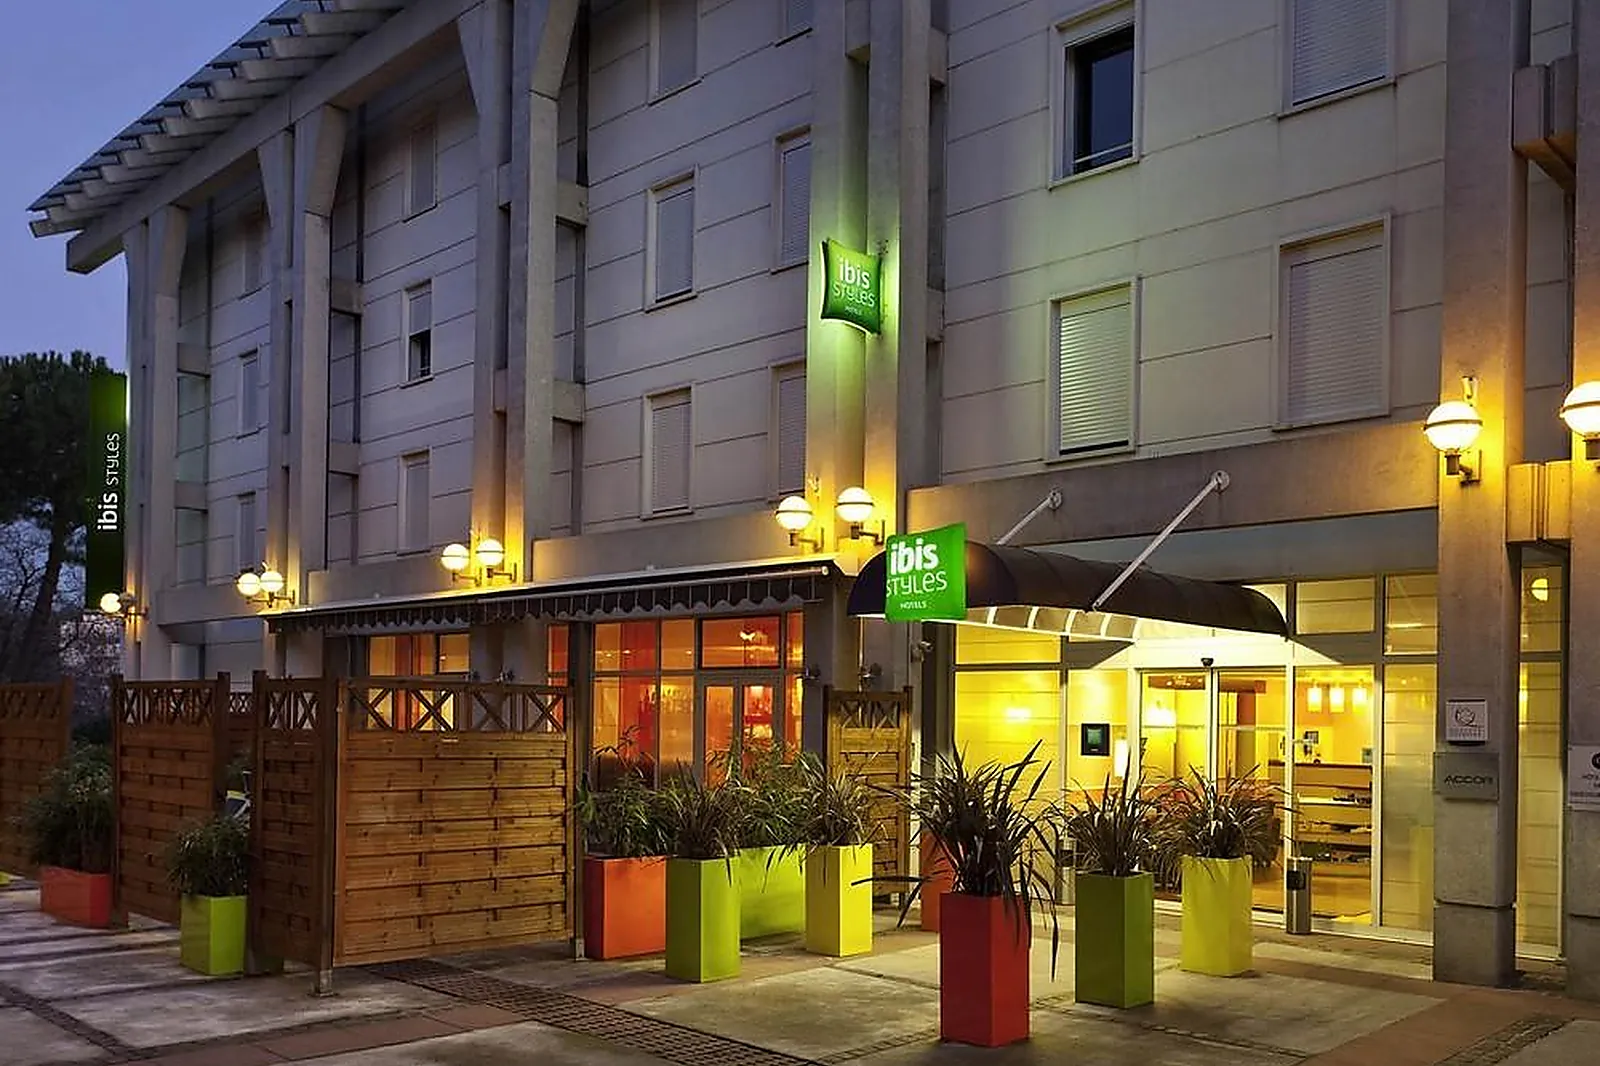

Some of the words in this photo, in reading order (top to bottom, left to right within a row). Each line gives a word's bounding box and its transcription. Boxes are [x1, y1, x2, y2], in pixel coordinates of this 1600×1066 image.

[838, 257, 870, 290] ibis
[97, 493, 118, 530] ibis
[890, 537, 939, 575] ibis
